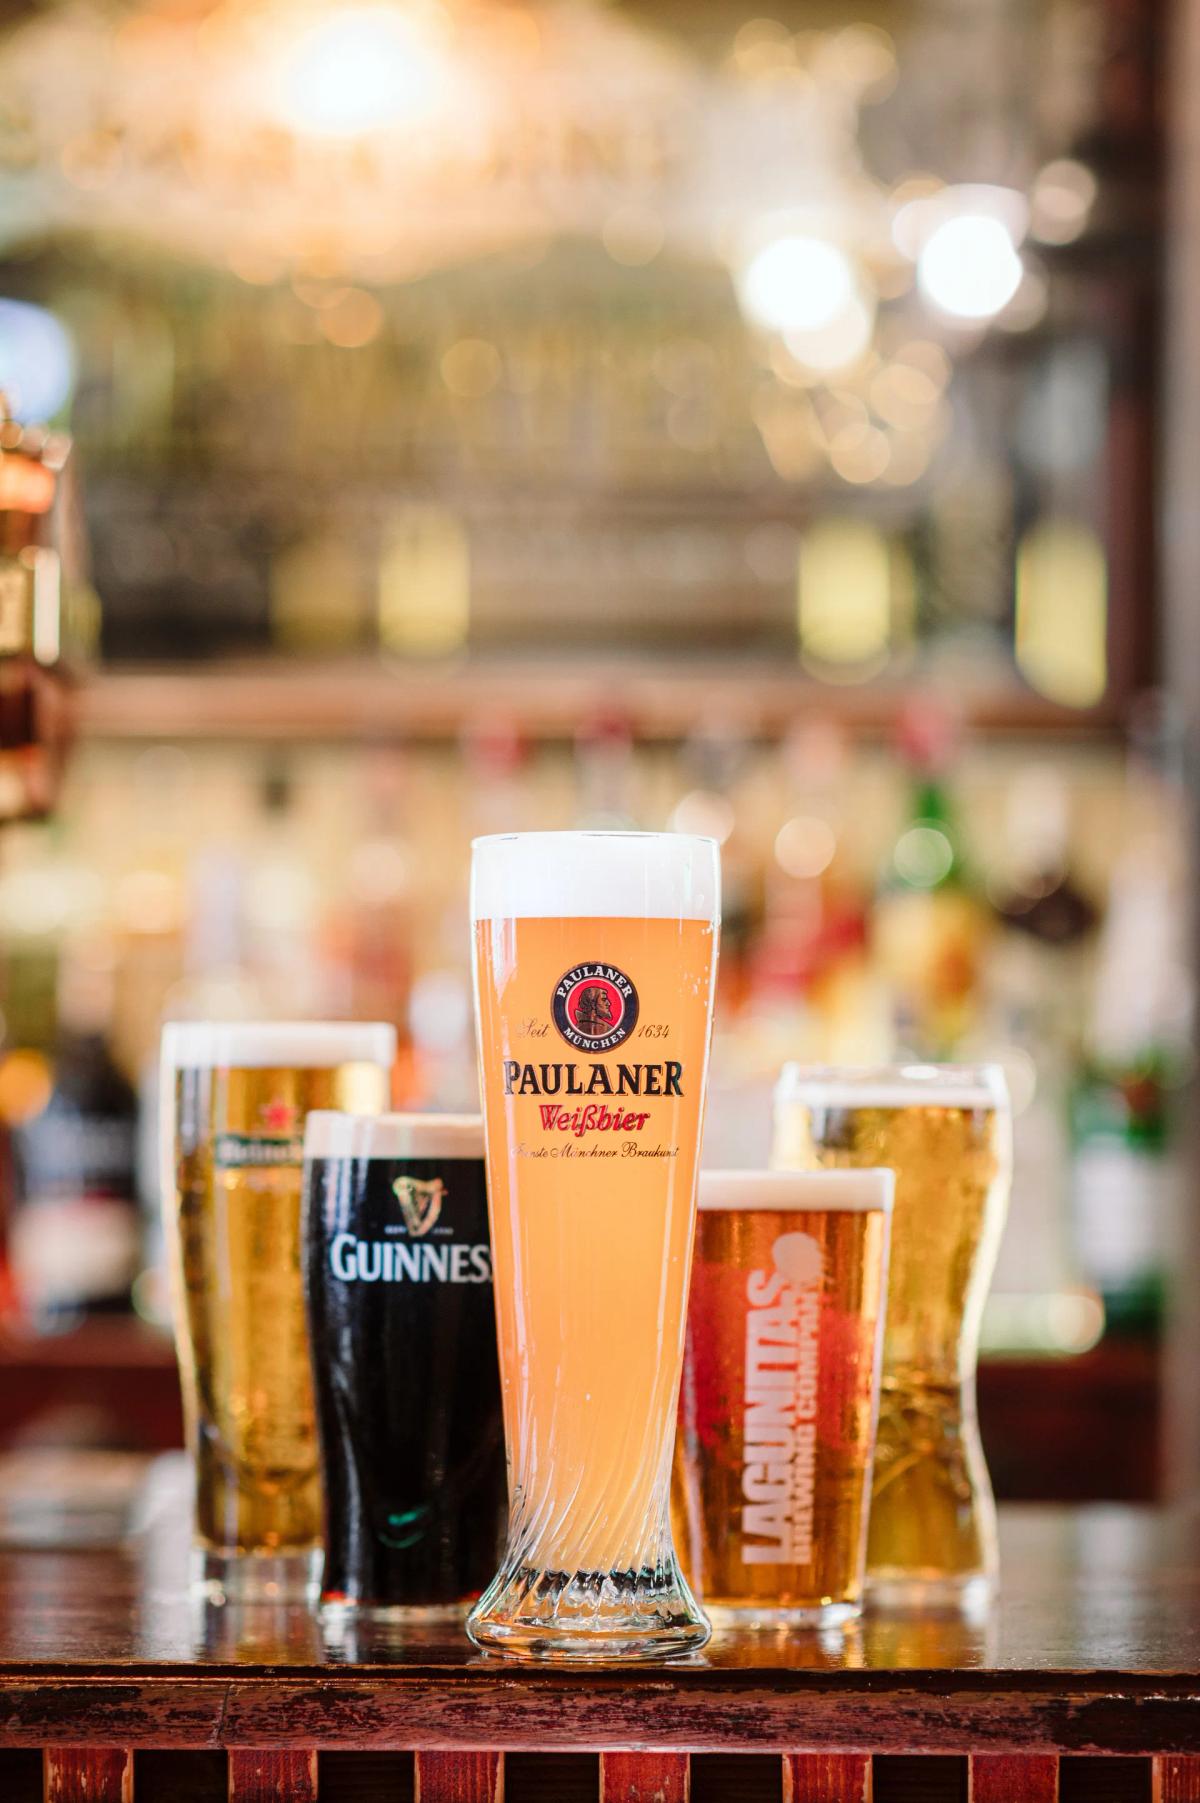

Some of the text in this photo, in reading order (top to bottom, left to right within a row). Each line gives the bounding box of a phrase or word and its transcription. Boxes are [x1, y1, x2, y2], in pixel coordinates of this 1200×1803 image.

[556, 965, 633, 998] PAULANER
[519, 1017, 670, 1039] Seit 1634
[563, 1027, 627, 1051] MÜNCHEN
[504, 1060, 684, 1097] PAULANER
[539, 1104, 651, 1138] Weißbier
[330, 1233, 493, 1283] GUINNES
[741, 1269, 798, 1565] LAGUNITAS
[793, 1424, 816, 1566] BREWING
